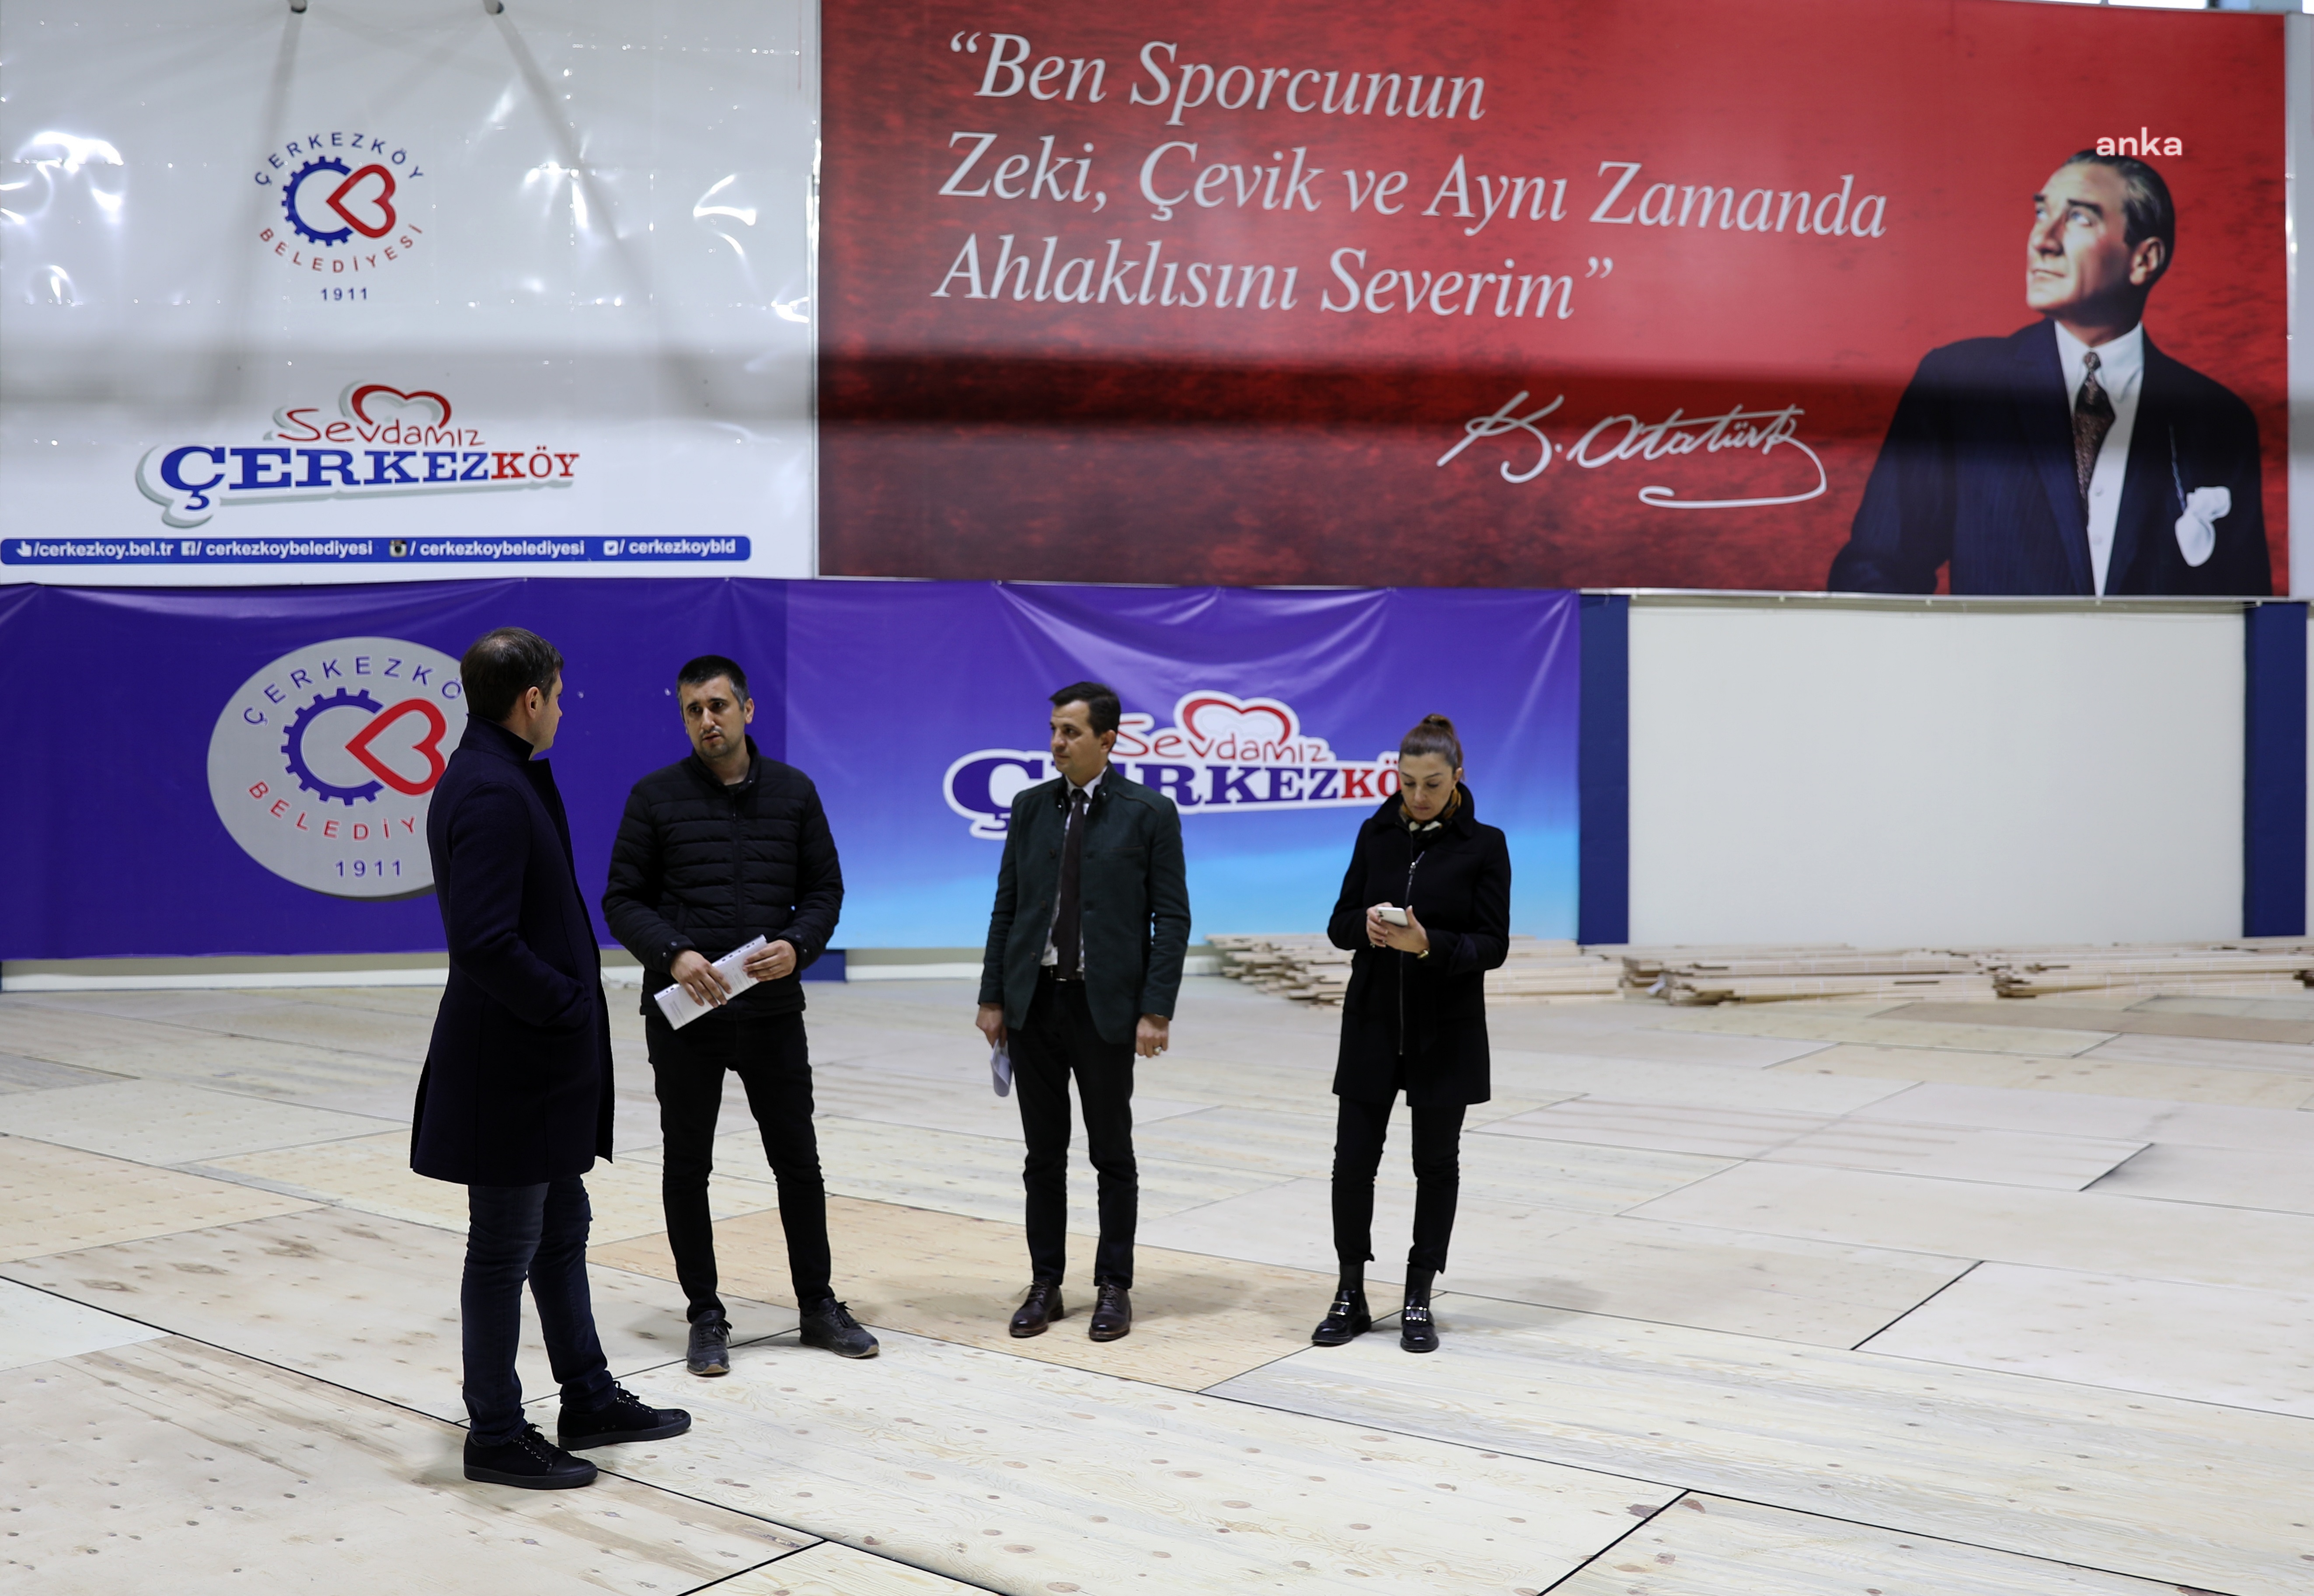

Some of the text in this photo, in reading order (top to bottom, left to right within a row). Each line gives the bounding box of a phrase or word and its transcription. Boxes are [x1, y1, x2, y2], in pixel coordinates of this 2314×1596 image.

[1129, 40, 1486, 126] Sporcunun
[254, 132, 424, 187] ÇERKEZKÖY
[938, 131, 1886, 238] Zeki, Çevik ve Aynı Zamanda
[260, 223, 423, 273] BELEDİYESİ
[930, 232, 1298, 310] Ahlaklısını
[321, 287, 368, 301] 1911
[277, 408, 485, 448] Sevdamız
[160, 445, 580, 509] ÇERKEZKÖY
[243, 656, 466, 727] ÇERKEZKÖ
[248, 781, 428, 841] BELEDİY
[335, 860, 401, 877] 1911
